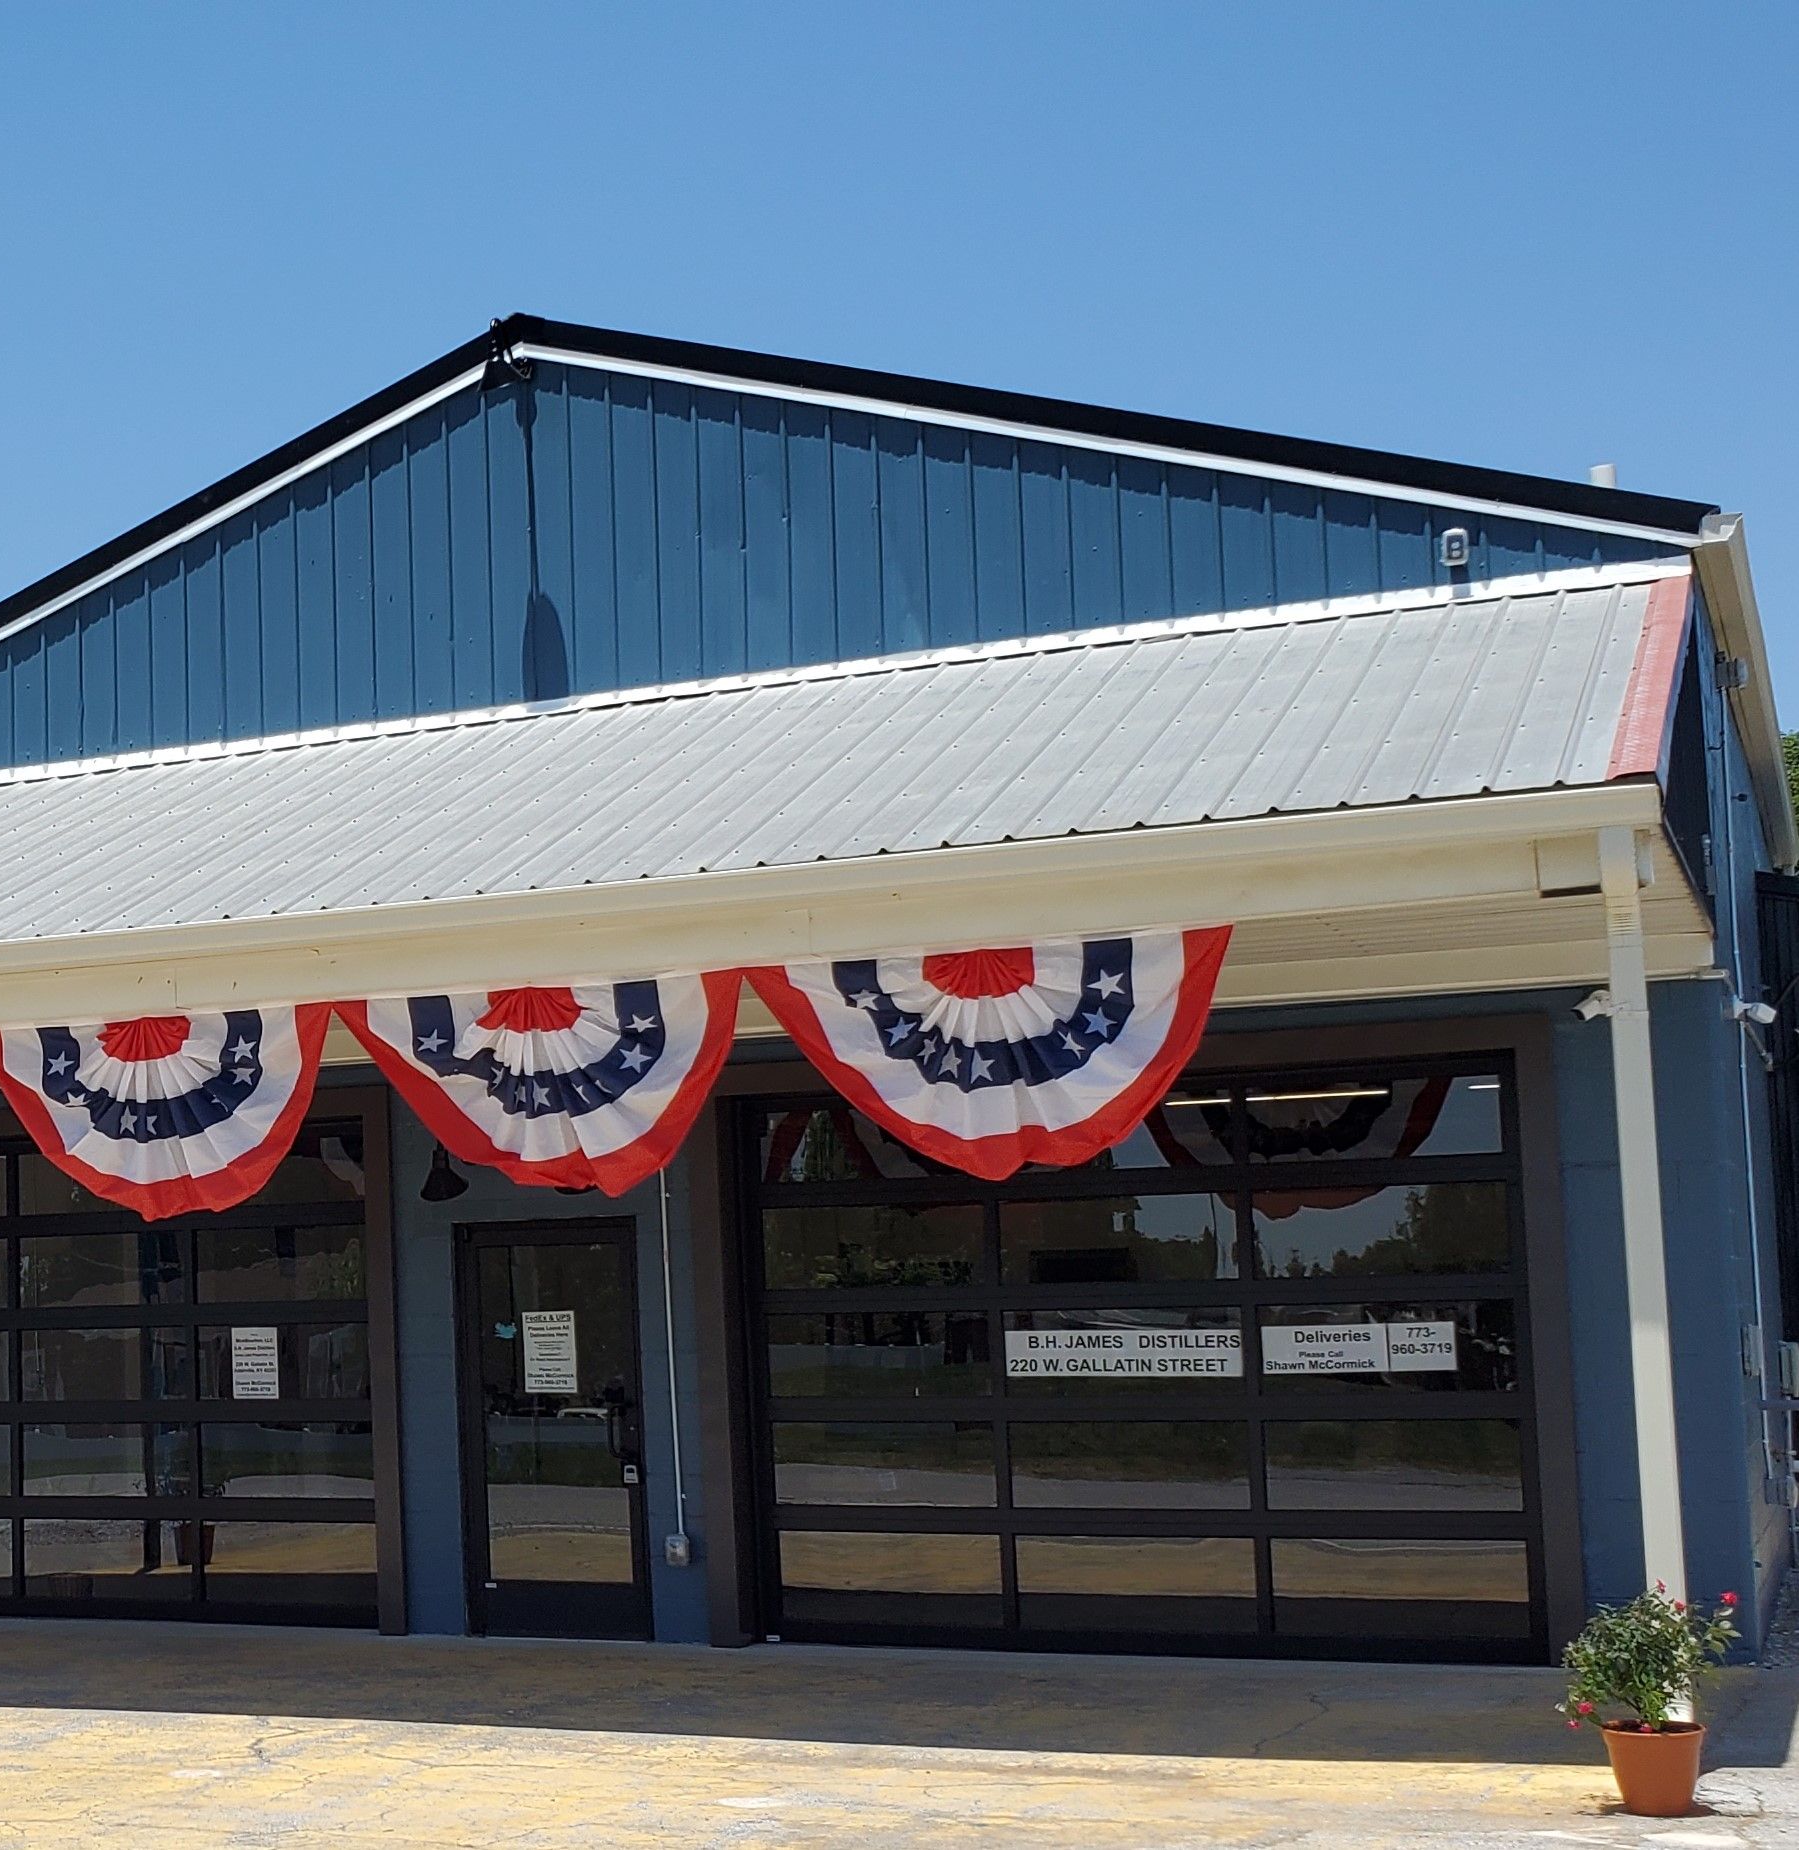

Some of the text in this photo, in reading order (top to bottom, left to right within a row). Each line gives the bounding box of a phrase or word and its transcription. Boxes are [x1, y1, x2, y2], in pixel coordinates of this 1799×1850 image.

[525, 1314, 548, 1322] FedEx
[555, 1313, 571, 1321] UPS
[1294, 1330, 1371, 1343] Deliveries
[1406, 1327, 1436, 1338] 773-
[1028, 1334, 1241, 1349] B.H. JAMES DISTILLERS
[1328, 1350, 1343, 1358] Call
[1391, 1342, 1452, 1354] 960-3719
[1010, 1358, 1228, 1372] 220 W. GALLATIN STREET
[1265, 1358, 1375, 1371] Shawn McCormick
